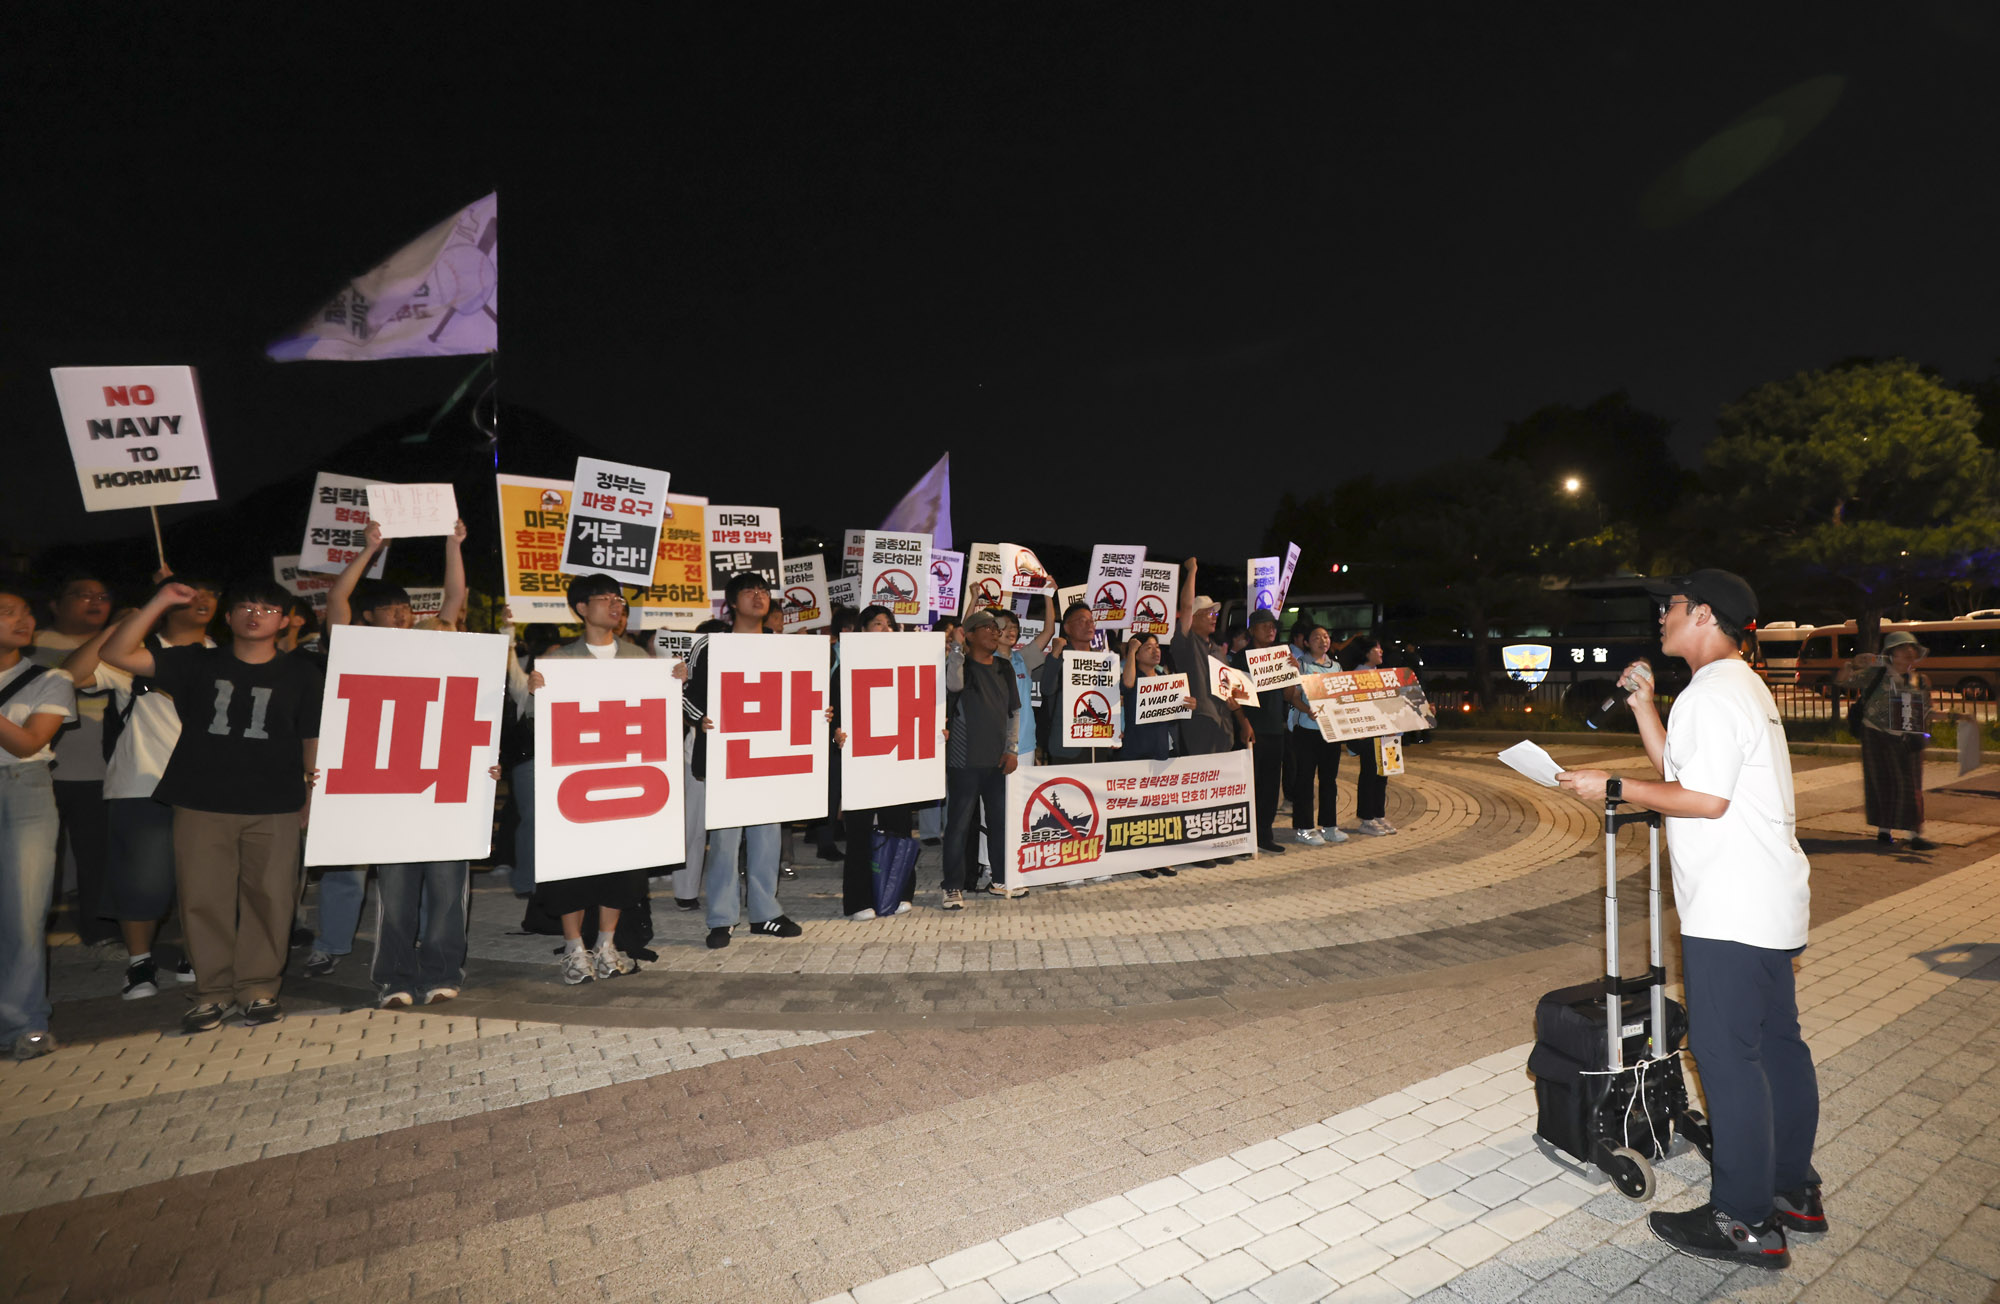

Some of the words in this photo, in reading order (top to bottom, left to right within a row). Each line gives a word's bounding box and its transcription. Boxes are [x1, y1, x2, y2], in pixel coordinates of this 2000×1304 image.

[102, 384, 155, 407] NO
[86, 415, 181, 440] NAVY
[126, 447, 159, 463] TO
[92, 465, 201, 489] HORMUZ!
[597, 472, 645, 494] 정부는
[582, 492, 616, 511] 파병
[619, 499, 653, 516] 요구
[524, 510, 569, 530] 미국
[719, 514, 760, 527] 미국의
[577, 521, 622, 543] 거부
[667, 528, 701, 542] 정부는
[712, 531, 740, 543] 파병
[744, 531, 772, 543] 압박
[875, 537, 922, 551] 굴종외교
[517, 551, 561, 571] 파병
[592, 546, 646, 568] 하라!
[715, 552, 752, 572] 규탄
[872, 552, 922, 566] 중단하라!
[1102, 553, 1135, 565] 침략전쟁
[1099, 566, 1132, 578] 가담하는
[1068, 592, 1085, 605] 미국
[1133, 622, 1168, 633] 파병반대
[658, 637, 692, 649] 국민을
[1249, 656, 1259, 665] DO
[1260, 653, 1271, 663] NOT
[1273, 650, 1288, 660] JOIN
[1571, 647, 1608, 663] 경찰
[1072, 659, 1111, 672] 파병논의
[1253, 668, 1258, 676] A
[1259, 665, 1275, 675] WAR
[1275, 663, 1283, 671] OF
[1072, 673, 1113, 687] 중단하라!
[1140, 685, 1151, 694] DO
[1153, 683, 1169, 692] NOT
[1170, 680, 1185, 690] JOIN
[1140, 698, 1146, 707] A
[1148, 696, 1168, 706] WAR
[1169, 693, 1179, 703] OF
[208, 679, 273, 739] 11
[851, 665, 937, 761] 대
[720, 671, 822, 779] 반
[1073, 725, 1113, 738] 파병반대
[325, 673, 492, 803] 파
[551, 698, 670, 823] 병
[1106, 777, 1136, 792] 미국은
[1139, 774, 1179, 789] 침략전쟁
[1181, 770, 1220, 785] 중단하라!
[1106, 797, 1138, 811] 정부는
[1140, 794, 1179, 808] 파병압박
[1181, 790, 1208, 804] 단호히
[1210, 784, 1247, 799] 거부하라!
[1109, 816, 1182, 847] 파병반대
[1184, 807, 1247, 839] 평화행진
[1021, 830, 1061, 844] 호르무즈
[1021, 837, 1100, 869] 파병반대
